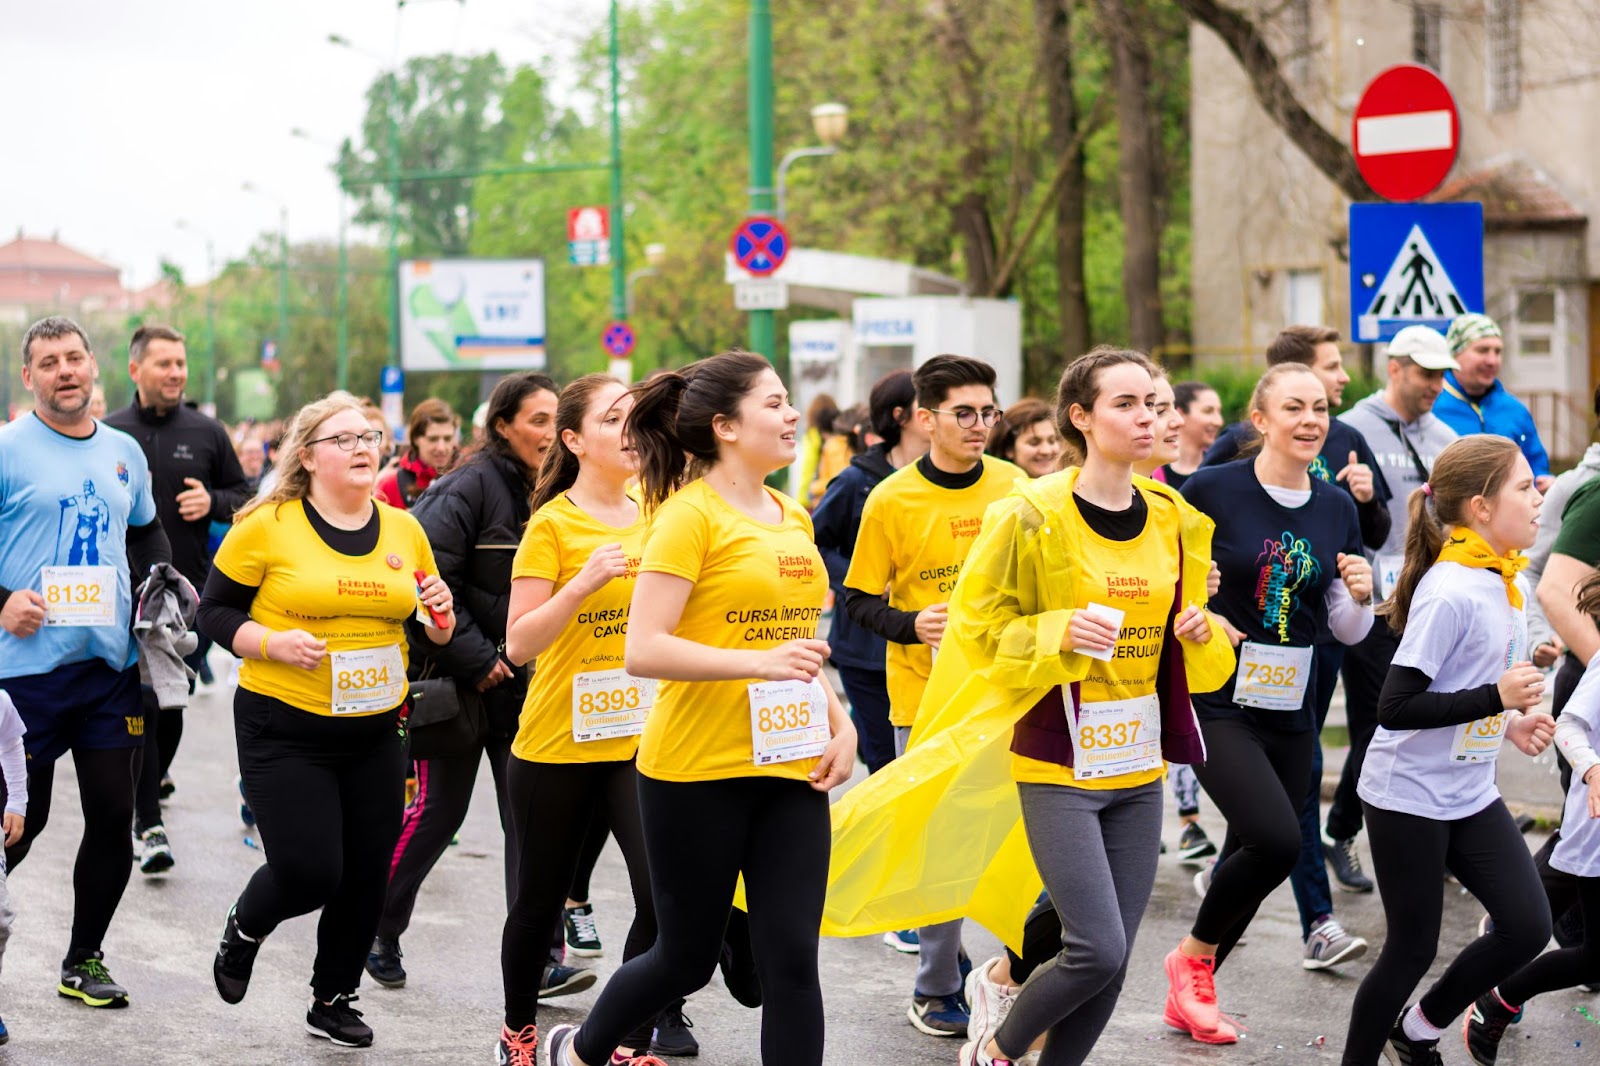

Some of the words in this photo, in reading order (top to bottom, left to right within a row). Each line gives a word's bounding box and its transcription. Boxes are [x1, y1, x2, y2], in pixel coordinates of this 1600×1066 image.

[778, 556, 812, 567] Little
[779, 567, 813, 579] People
[919, 564, 959, 581] CURSA
[337, 579, 386, 589] Little
[1106, 577, 1149, 587] Little
[47, 584, 101, 604] 8132
[337, 588, 388, 598] People
[1107, 588, 1150, 600] People
[577, 608, 624, 624] CURSA
[726, 608, 778, 624] CURSA
[1278, 587, 1291, 644] TIMOTION
[593, 622, 628, 639] CANC
[337, 665, 390, 691] 8334
[1244, 661, 1297, 687] 7352
[578, 686, 641, 715] 8393
[585, 713, 630, 728] Continental
[758, 701, 811, 733] 8335
[1079, 719, 1142, 750] 8337
[1087, 749, 1132, 764] Continental
